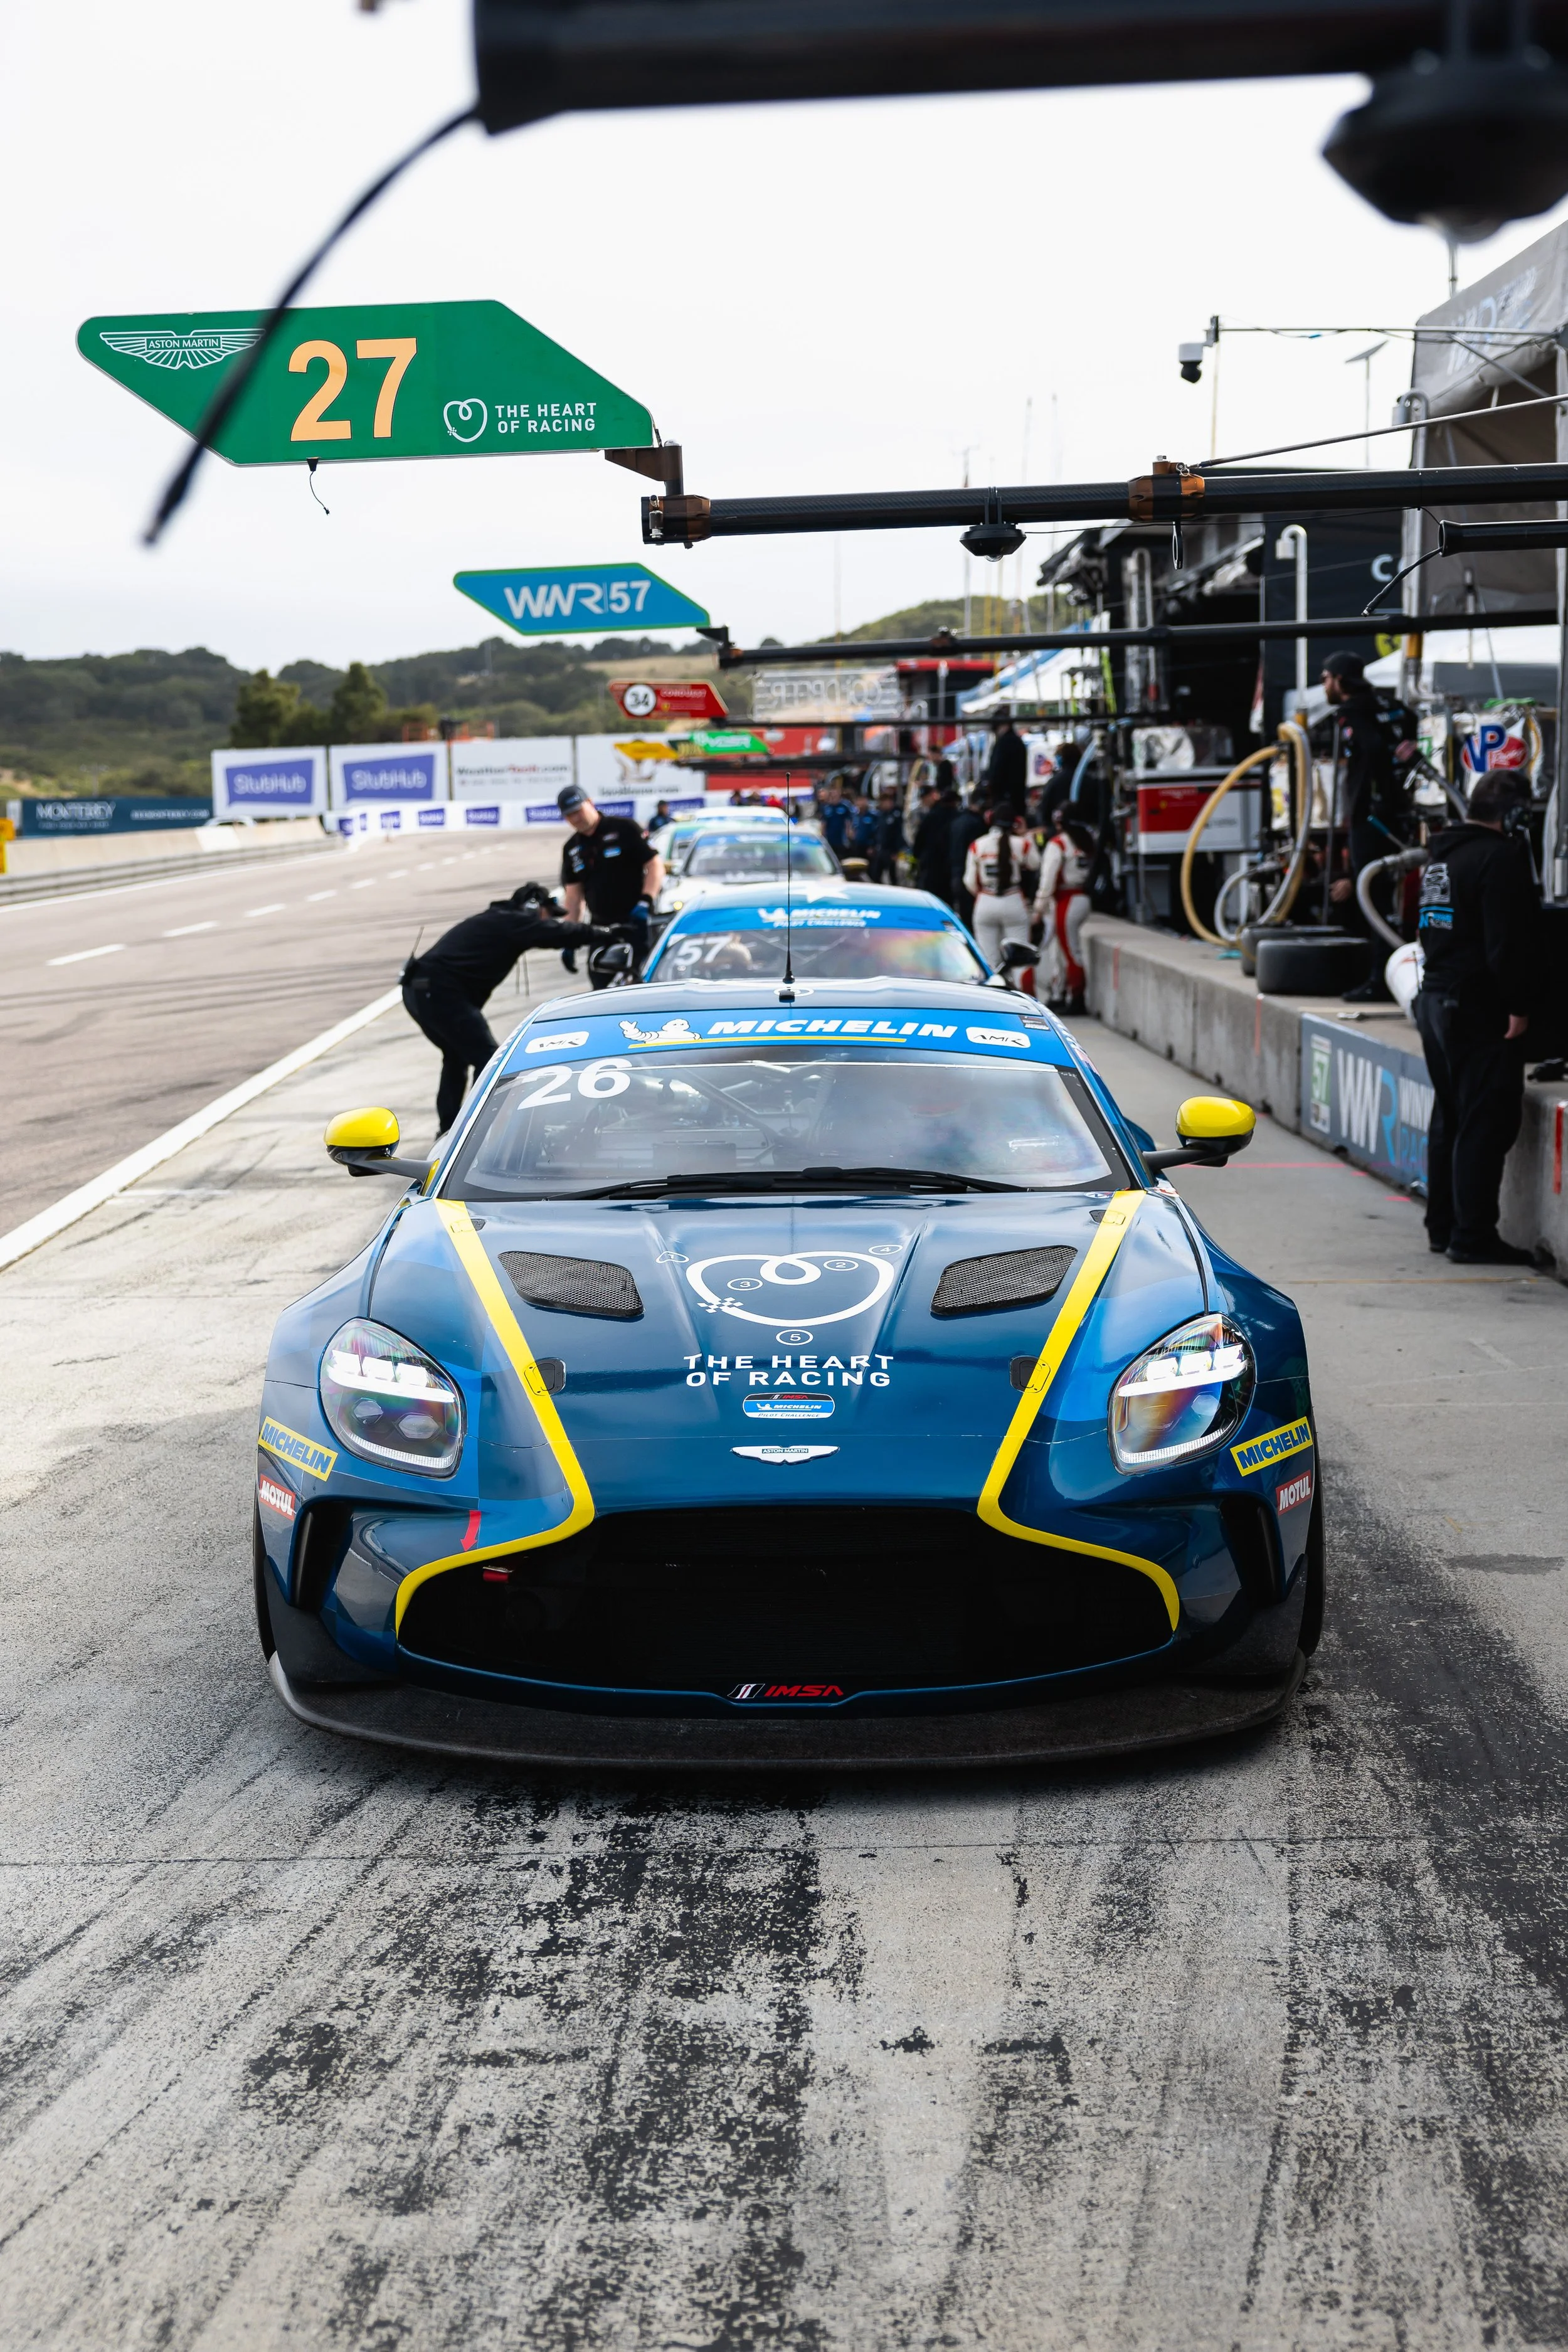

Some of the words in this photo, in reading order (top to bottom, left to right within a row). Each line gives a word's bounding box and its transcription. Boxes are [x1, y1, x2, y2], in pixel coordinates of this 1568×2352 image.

[148, 340, 180, 349] ASTON
[182, 338, 219, 347] MARTIN
[288, 337, 418, 442] 27
[495, 404, 530, 418] THE
[537, 402, 597, 416] HEART
[497, 420, 520, 434] OF
[527, 418, 596, 433] RACING
[608, 580, 651, 613] 57
[233, 771, 307, 795] StubHub
[351, 767, 426, 791] StubHub
[674, 935, 733, 965] 57
[707, 1020, 958, 1038] MICHELIN
[517, 1058, 632, 1110] 26
[1312, 1051, 1330, 1102] 57
[684, 1353, 753, 1369] THE
[772, 1354, 894, 1369] HEART
[686, 1372, 731, 1387] OF
[749, 1372, 890, 1387] RACING
[262, 1422, 332, 1474] MICHELIN
[1236, 1422, 1310, 1470] MICHELIN
[261, 1480, 293, 1515] MOTUL
[1279, 1476, 1311, 1511] MOTUL
[764, 1685, 844, 1697] IMSA
